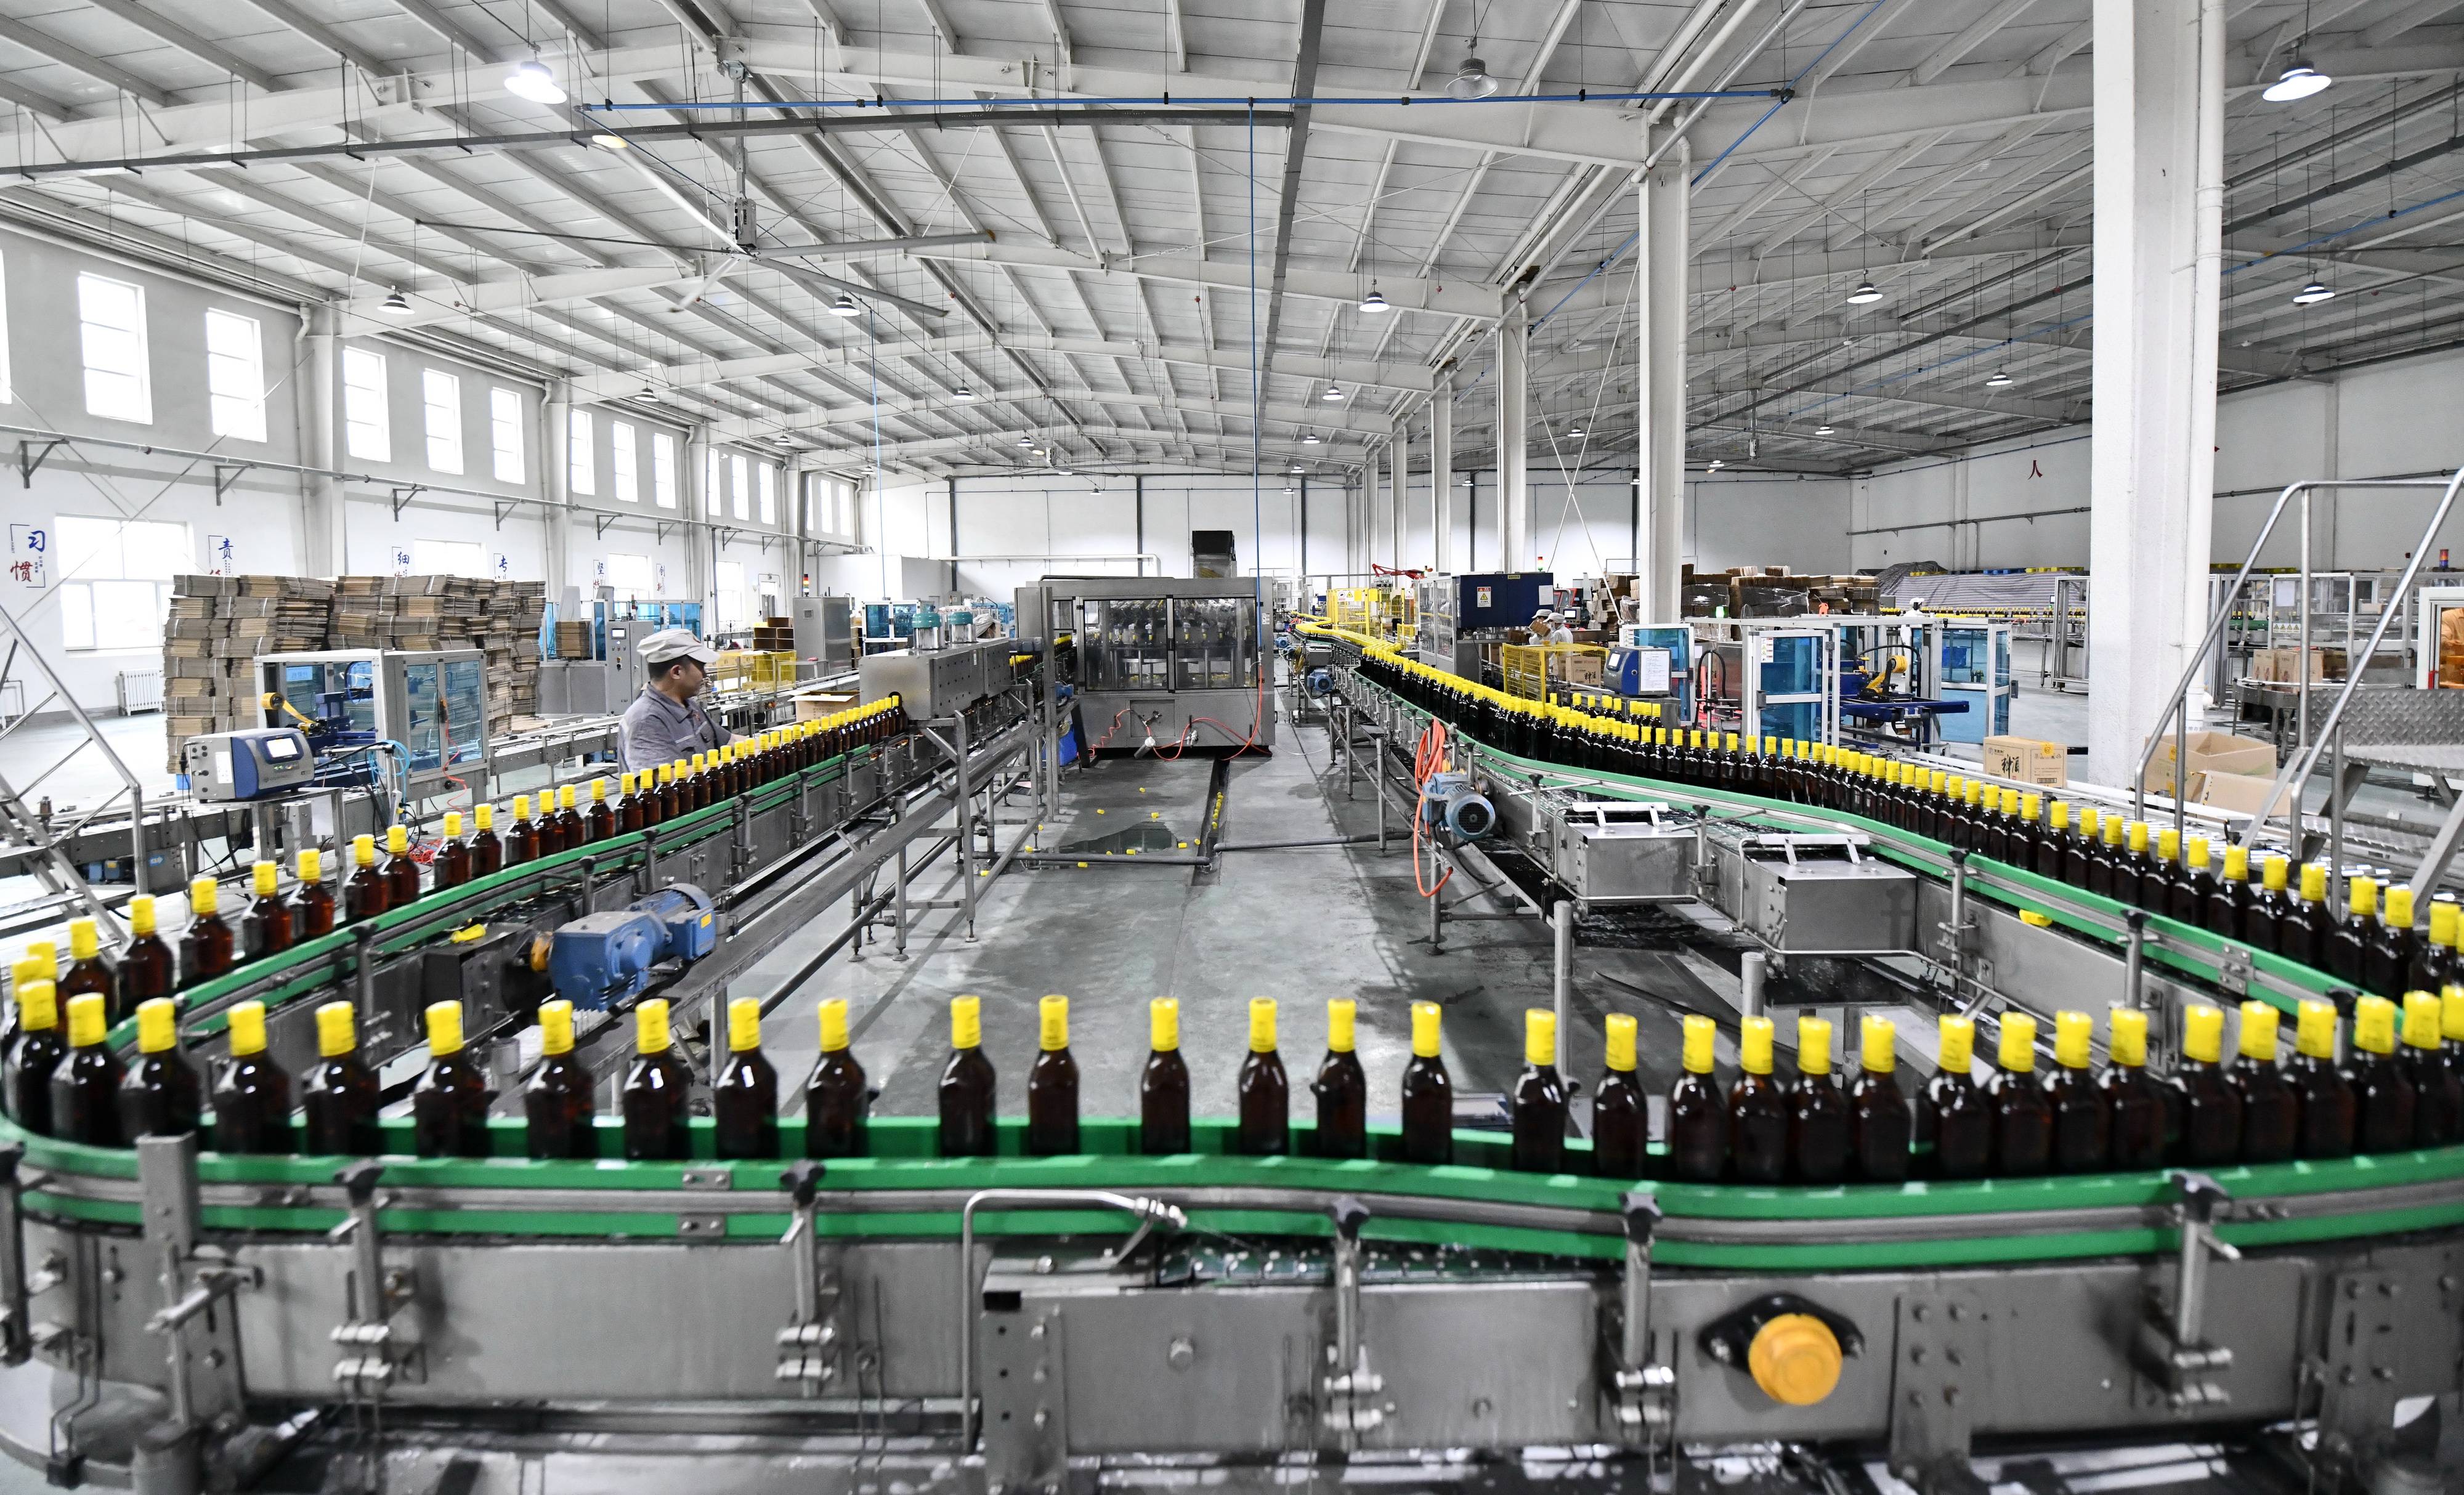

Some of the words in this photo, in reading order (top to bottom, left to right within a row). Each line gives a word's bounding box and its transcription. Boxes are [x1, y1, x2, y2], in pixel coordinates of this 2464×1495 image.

[2026, 460, 2043, 480] 人
[218, 538, 233, 559] 责
[397, 551, 410, 565] 细
[2001, 753, 2020, 779] 料酒
